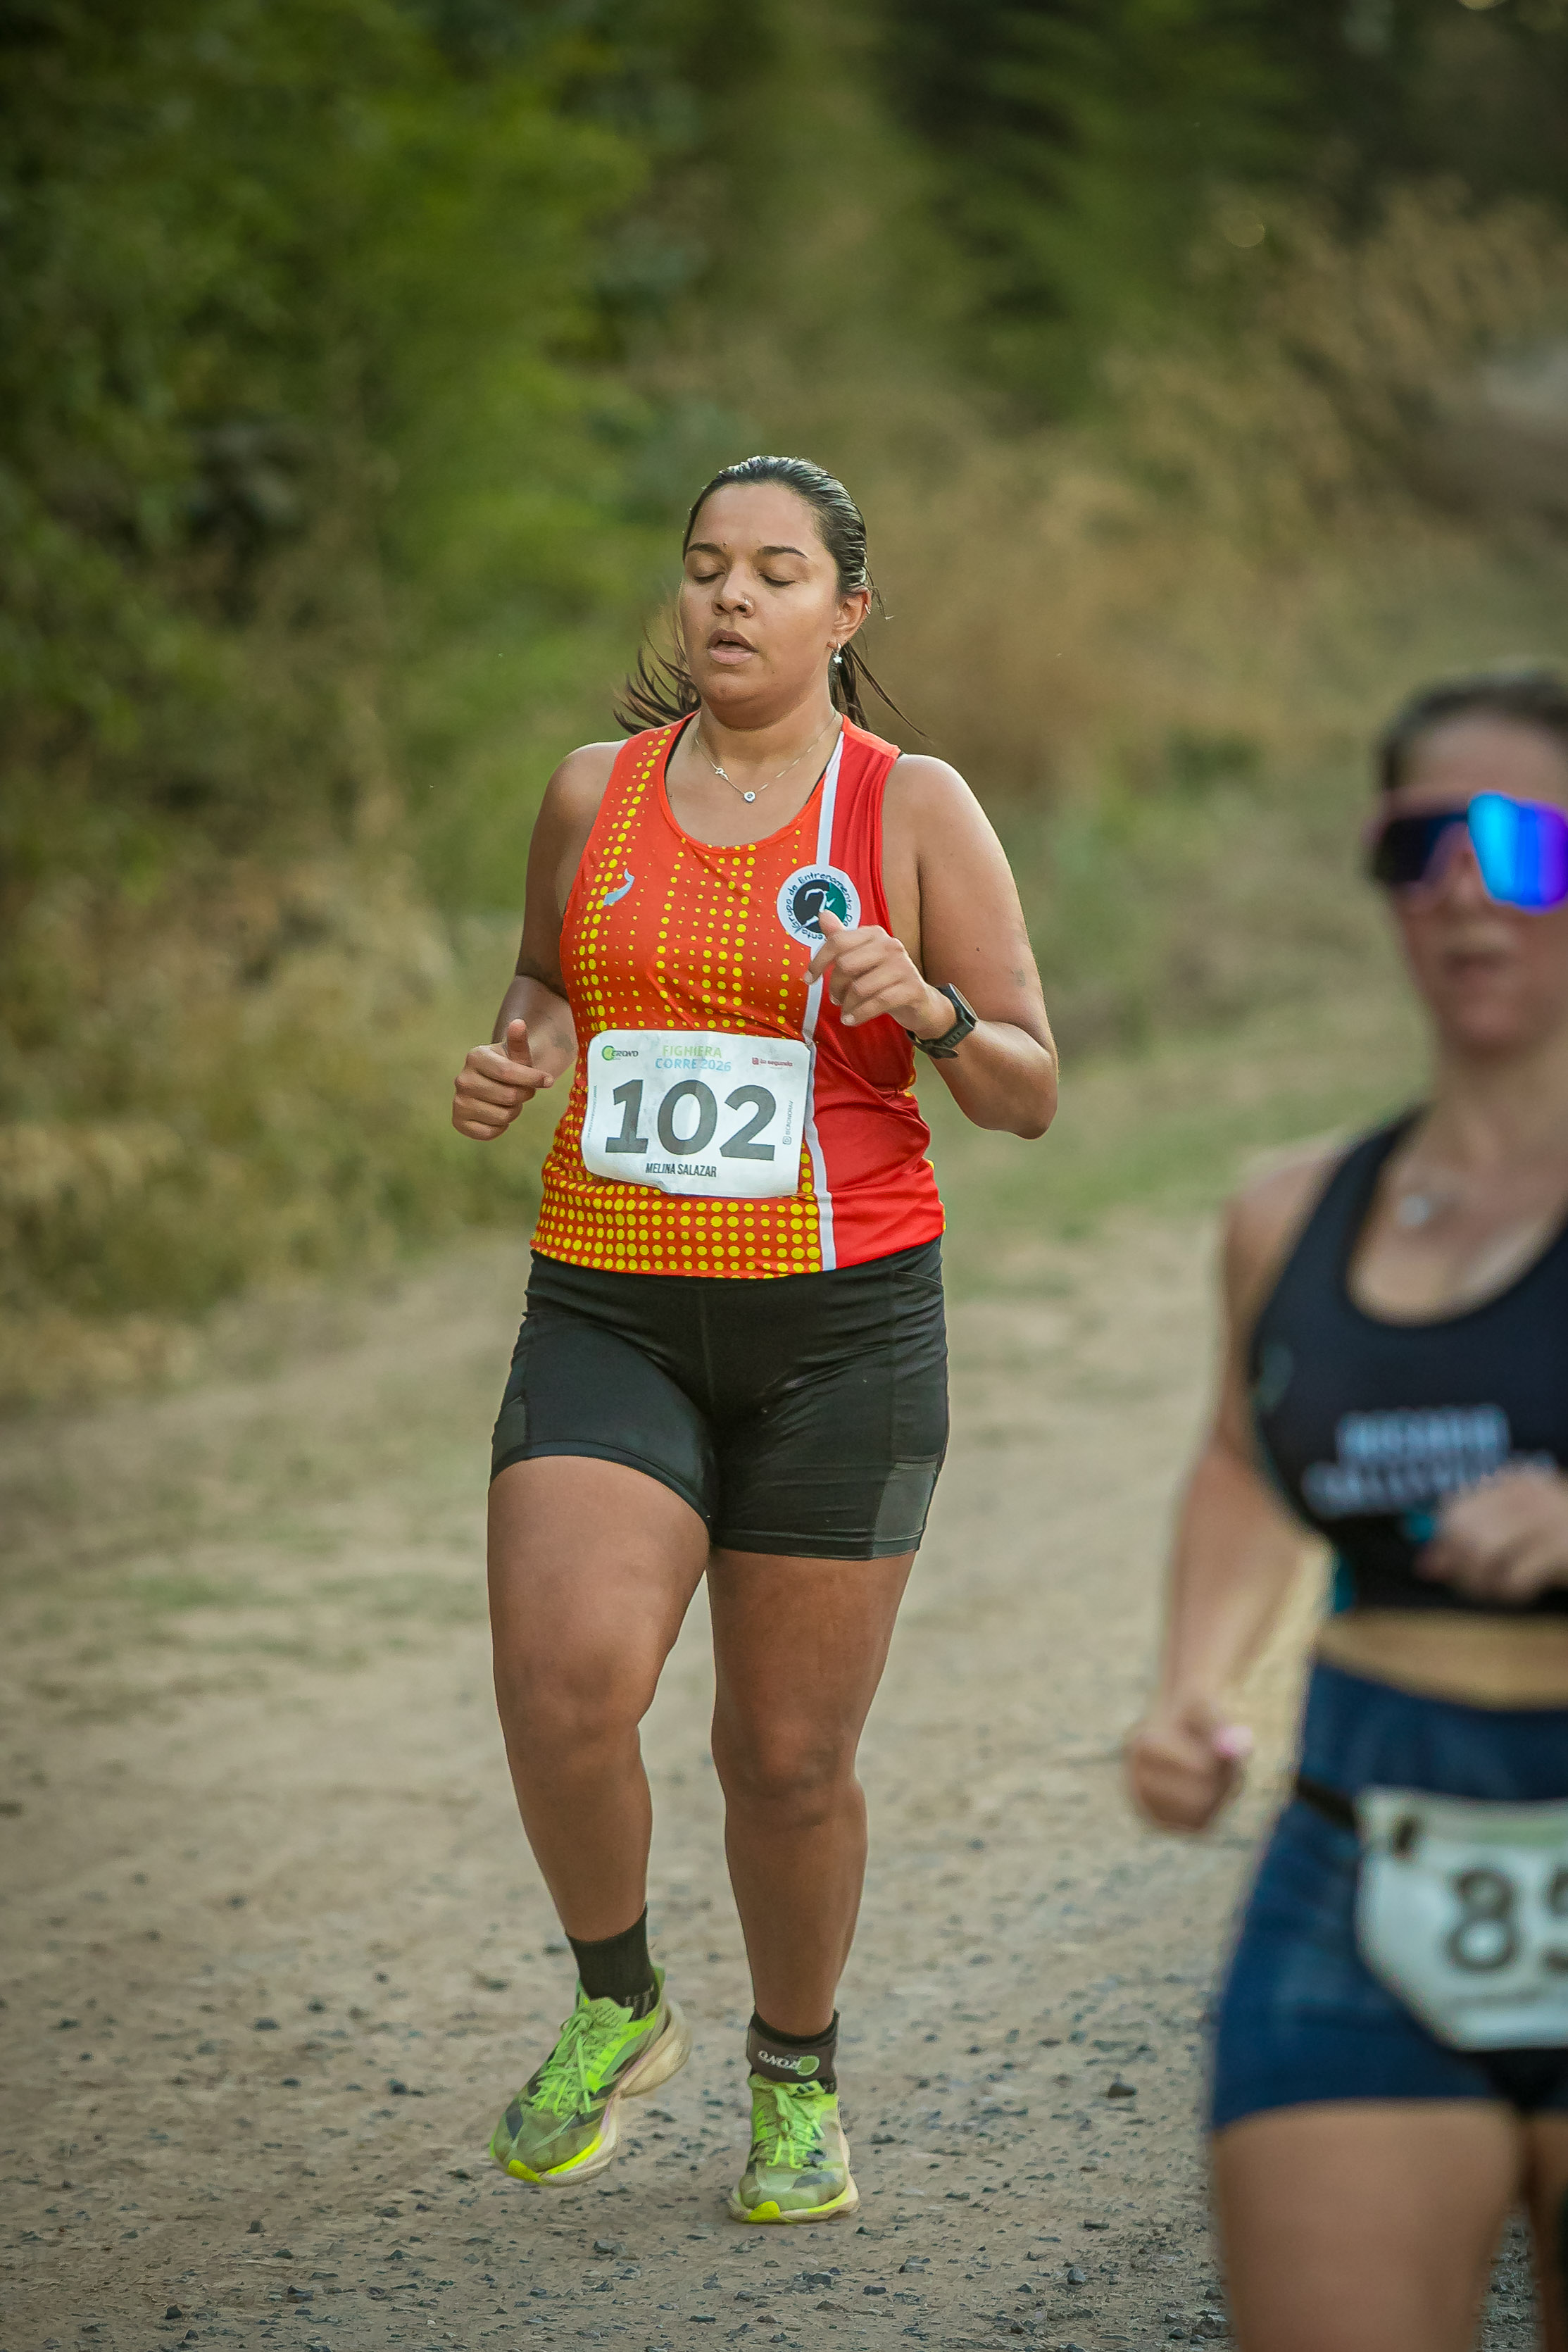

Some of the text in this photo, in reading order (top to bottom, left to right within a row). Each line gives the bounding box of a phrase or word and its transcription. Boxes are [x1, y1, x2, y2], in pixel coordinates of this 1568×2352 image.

[786, 899, 800, 928] Grupo
[663, 1045, 722, 1058] FIGHIERA
[655, 1058, 732, 1072] CORRE 2026
[606, 1080, 777, 1161] 102
[645, 1163, 717, 1177] MELINA SALAZAR
